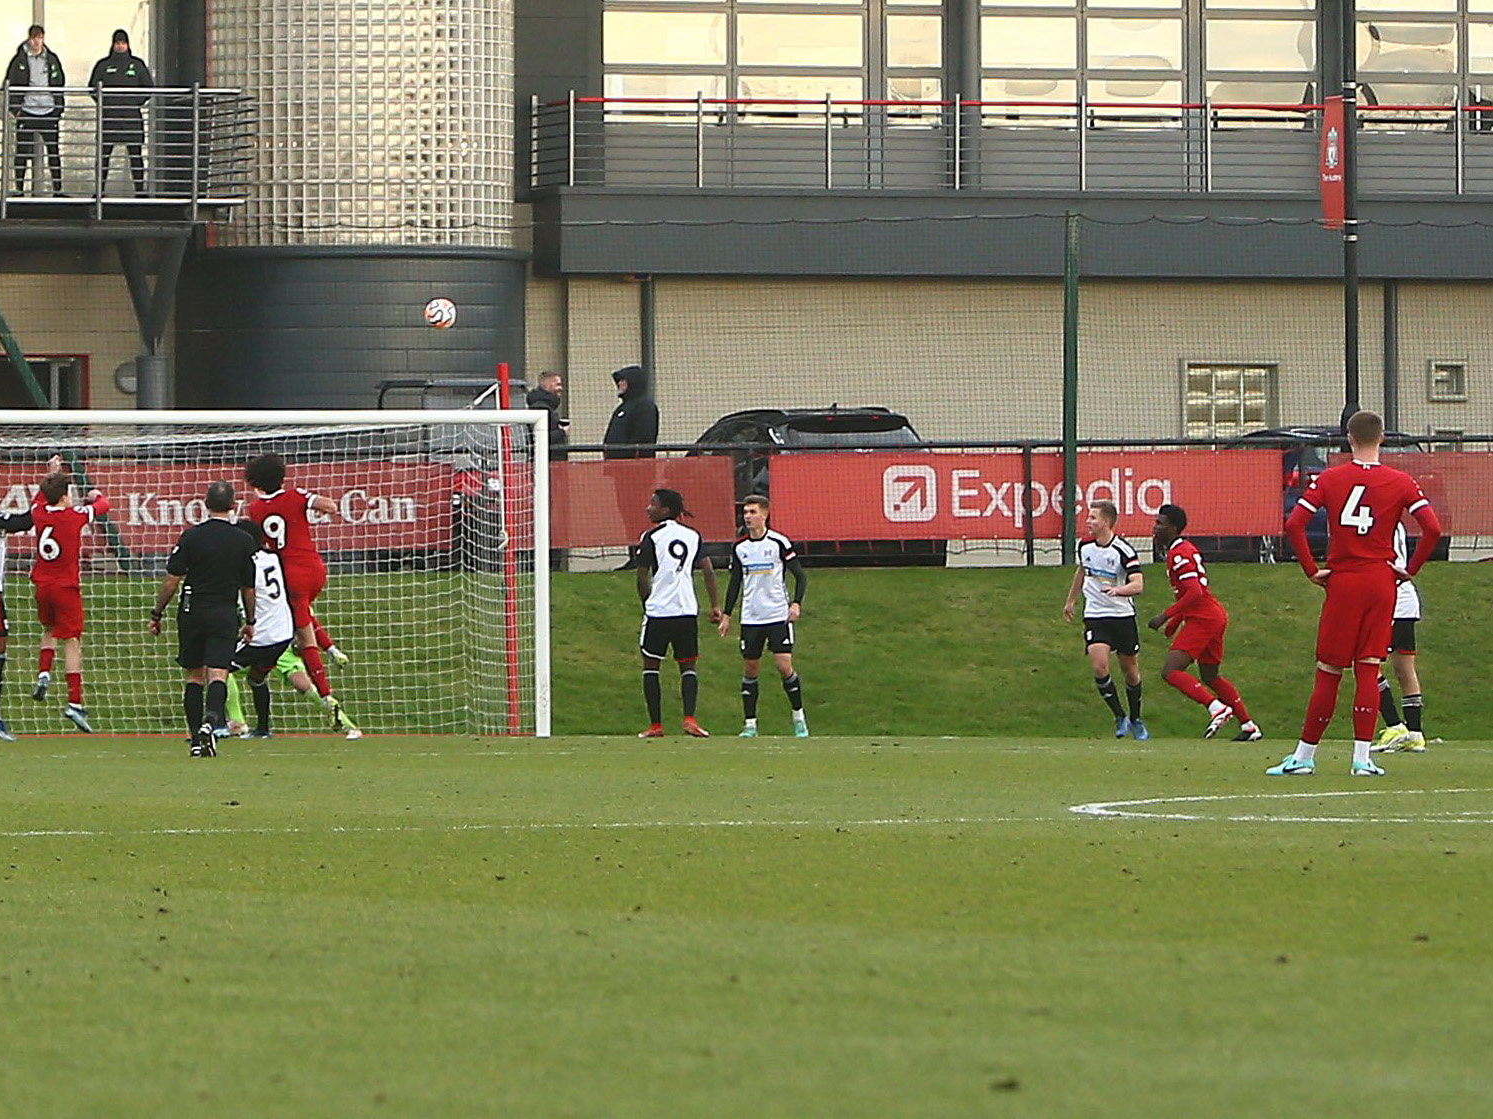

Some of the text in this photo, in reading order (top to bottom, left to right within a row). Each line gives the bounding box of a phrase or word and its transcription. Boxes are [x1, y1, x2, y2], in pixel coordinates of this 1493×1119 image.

[340, 489, 418, 525] Can
[951, 467, 1172, 528] Expedia
[1340, 485, 1374, 535] 4
[39, 526, 60, 560] 6
[263, 515, 285, 549] 9
[668, 539, 689, 572] 9
[263, 566, 281, 600] 5
